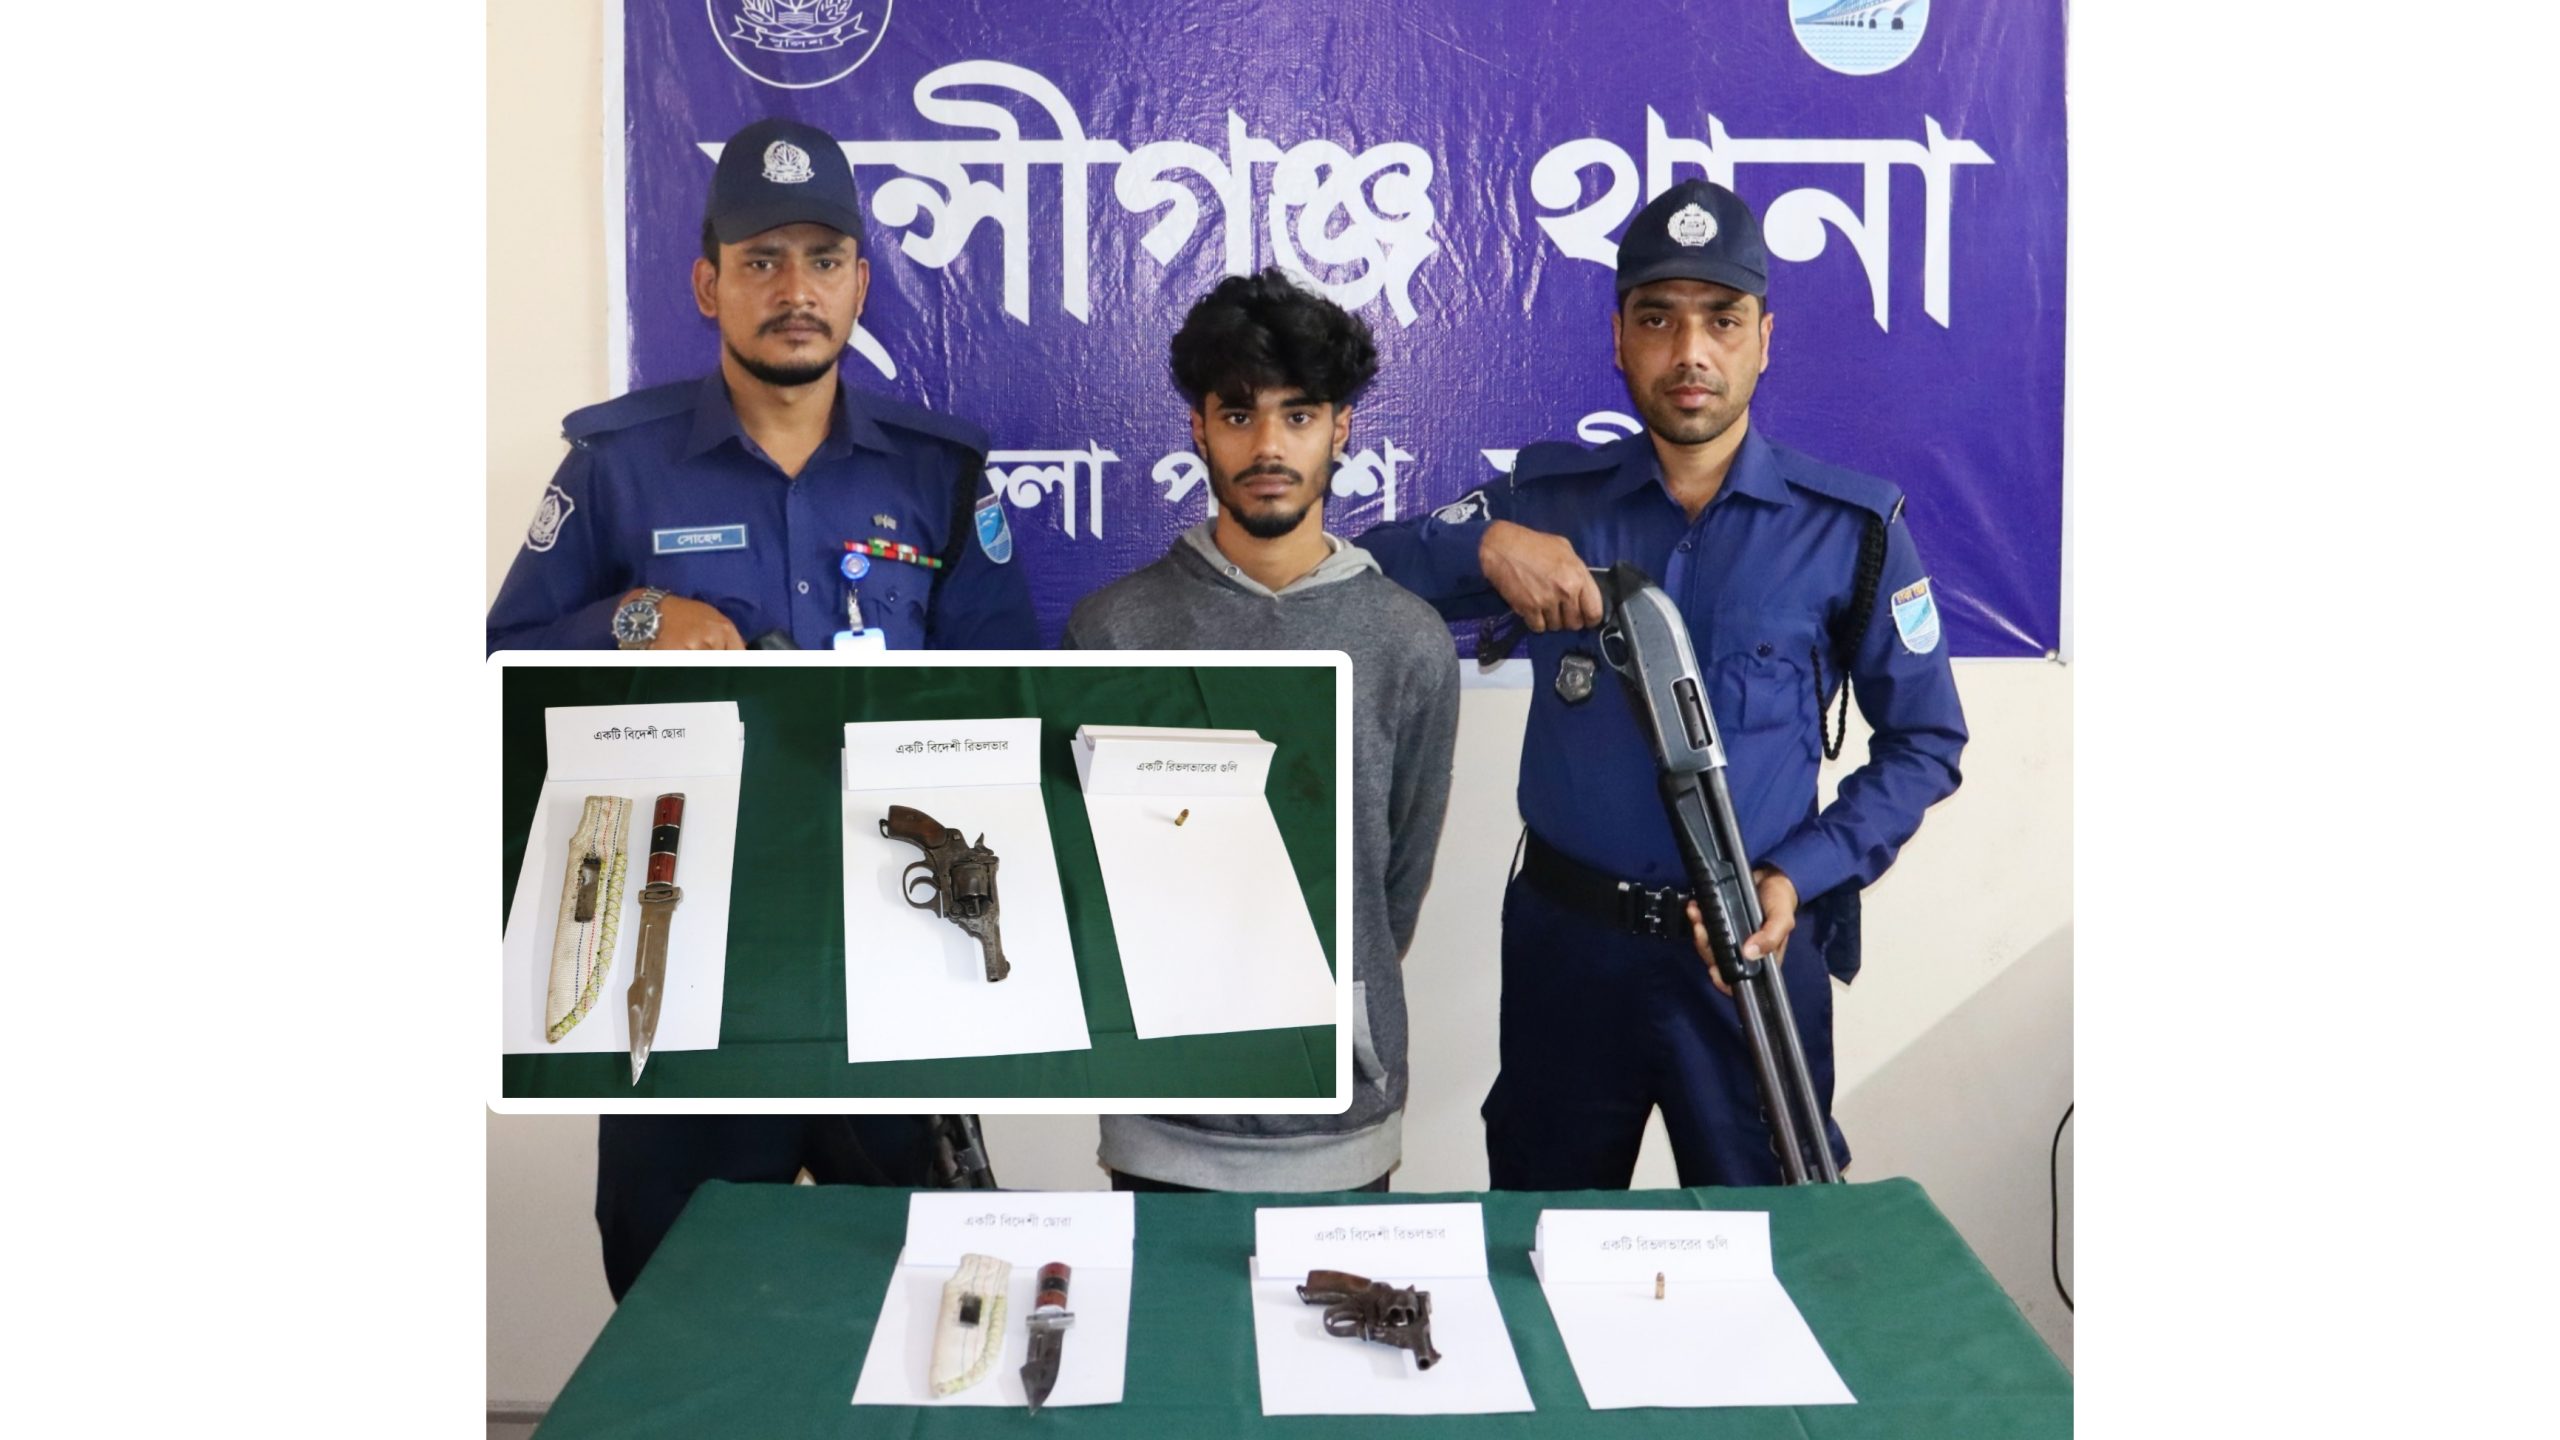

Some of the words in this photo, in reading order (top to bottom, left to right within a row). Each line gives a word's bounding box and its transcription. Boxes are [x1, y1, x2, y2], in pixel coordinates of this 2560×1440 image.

[697, 60, 1438, 380] ন্সীগঞ্জ
[677, 532, 722, 545] সোহেল
[593, 726, 621, 741] একটি
[624, 725, 658, 741] বিদেশী
[661, 727, 686, 740] ছোরা
[895, 740, 924, 755] একটি
[926, 738, 961, 754] বিদেশী
[963, 738, 1009, 753] রিভলভার
[1136, 759, 1164, 772] একটি
[1165, 759, 1217, 773] রিভলভারের
[1219, 760, 1239, 773] গুলি
[963, 1212, 997, 1227] একটি
[1314, 1226, 1347, 1242] একটি
[1349, 1225, 1390, 1242] বিদেশী
[1392, 1225, 1447, 1241] রিভলভার
[1599, 1235, 1633, 1251] একটি
